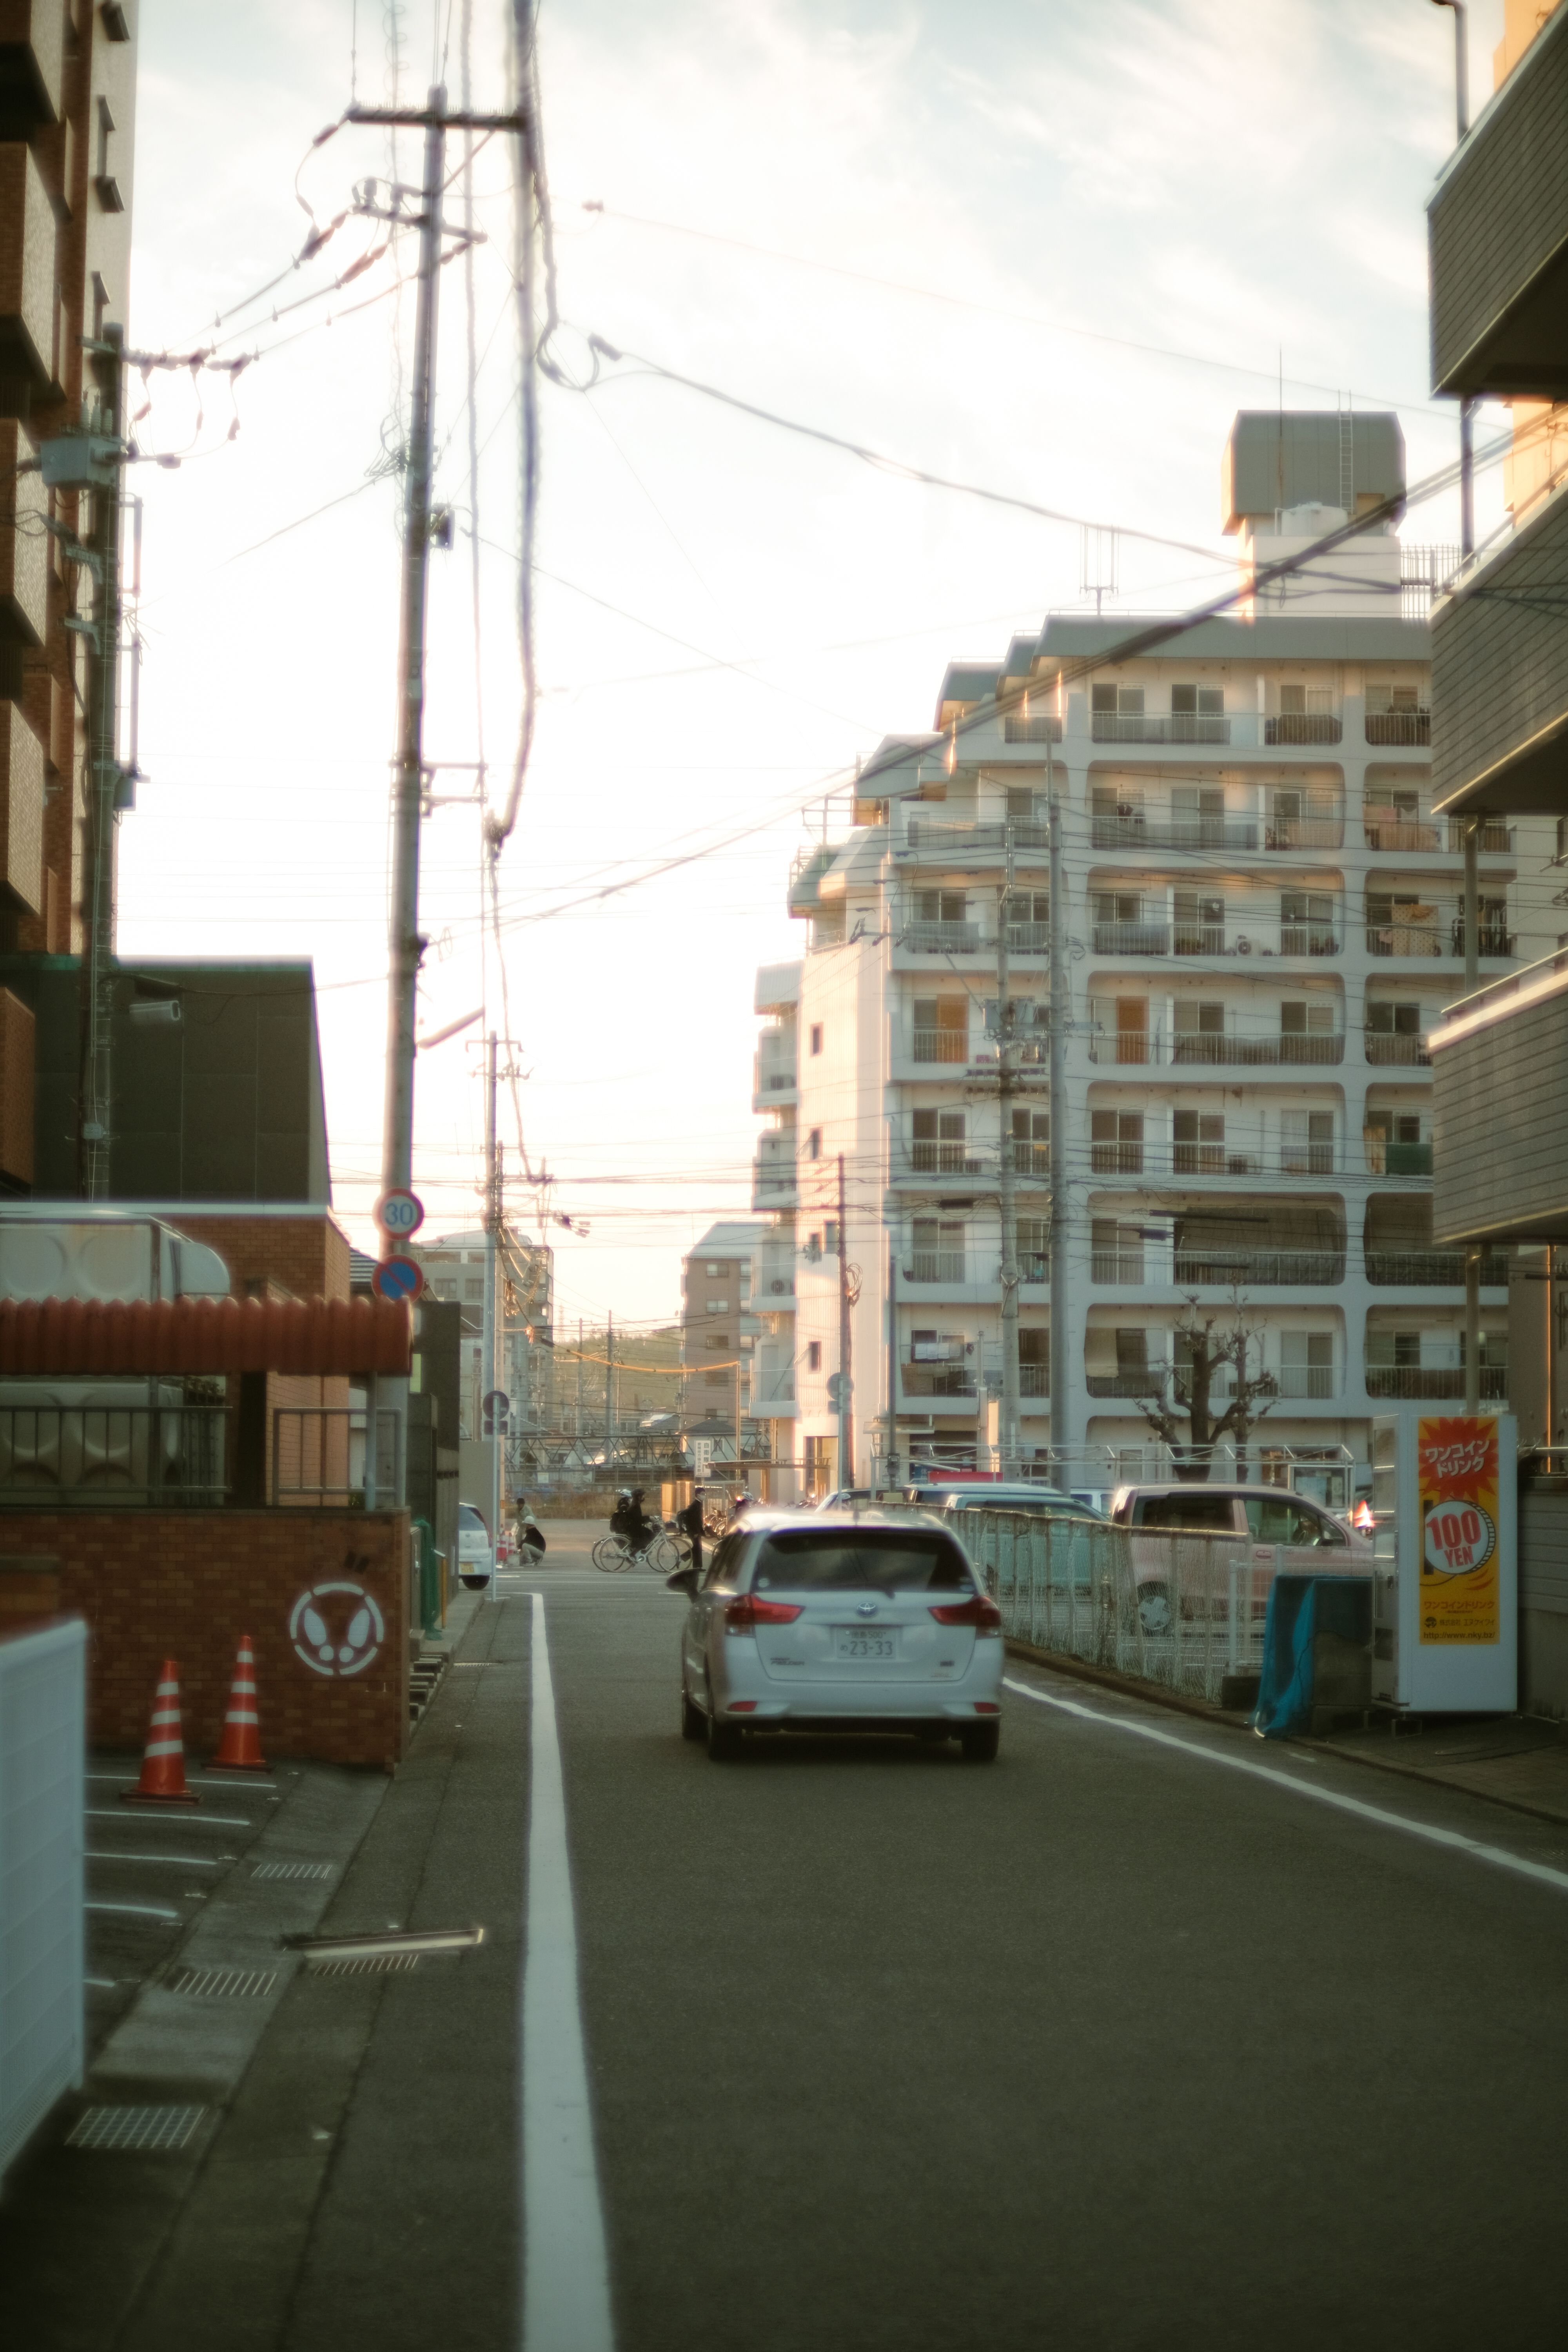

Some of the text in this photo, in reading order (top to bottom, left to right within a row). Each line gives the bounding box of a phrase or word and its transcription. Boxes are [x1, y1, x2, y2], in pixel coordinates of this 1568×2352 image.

[385, 1203, 413, 1225] 30
[1425, 1440, 1489, 1463] ワンコイン
[1437, 1456, 1484, 1478] ドリンク
[1426, 1510, 1481, 1550] 100
[1444, 1546, 1474, 1568] YEN
[1424, 1601, 1495, 1609] ワンコインドリンク
[1423, 1632, 1495, 1640] http://www.nky.bz/
[850, 1641, 893, 1655] 23-33
